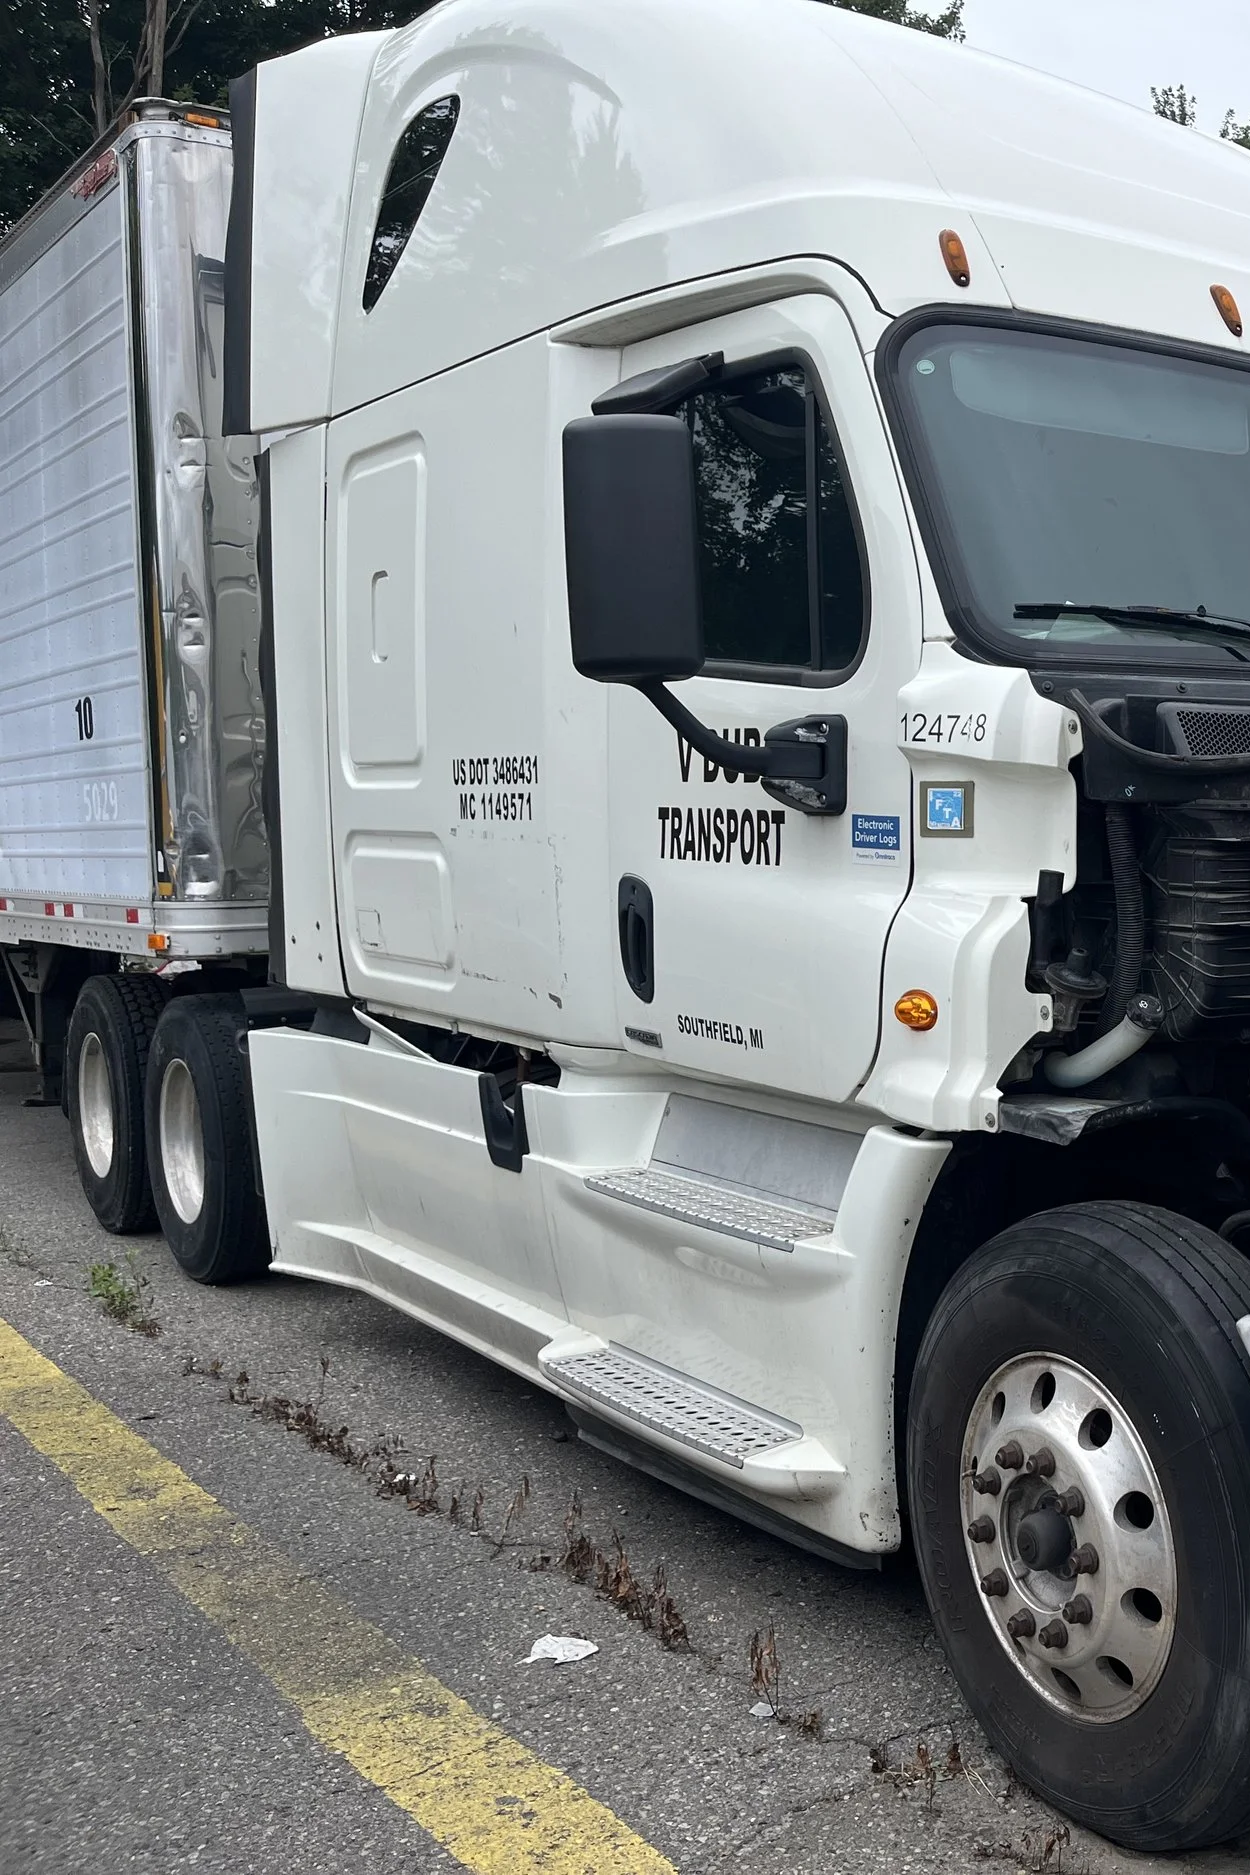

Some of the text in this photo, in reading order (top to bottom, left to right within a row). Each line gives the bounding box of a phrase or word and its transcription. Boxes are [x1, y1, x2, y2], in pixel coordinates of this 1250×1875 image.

[75, 696, 94, 741] 10
[900, 712, 987, 743] 124748
[452, 755, 538, 786] US DOT 3486431
[83, 781, 118, 821] 5029
[460, 792, 532, 821] MC 1149571
[658, 806, 786, 867] TRANSPORT
[855, 831, 897, 846] Driver Logs
[857, 818, 894, 831] Electronic
[677, 1014, 748, 1051] SOUTHFIELD,
[749, 1027, 764, 1049] MI
